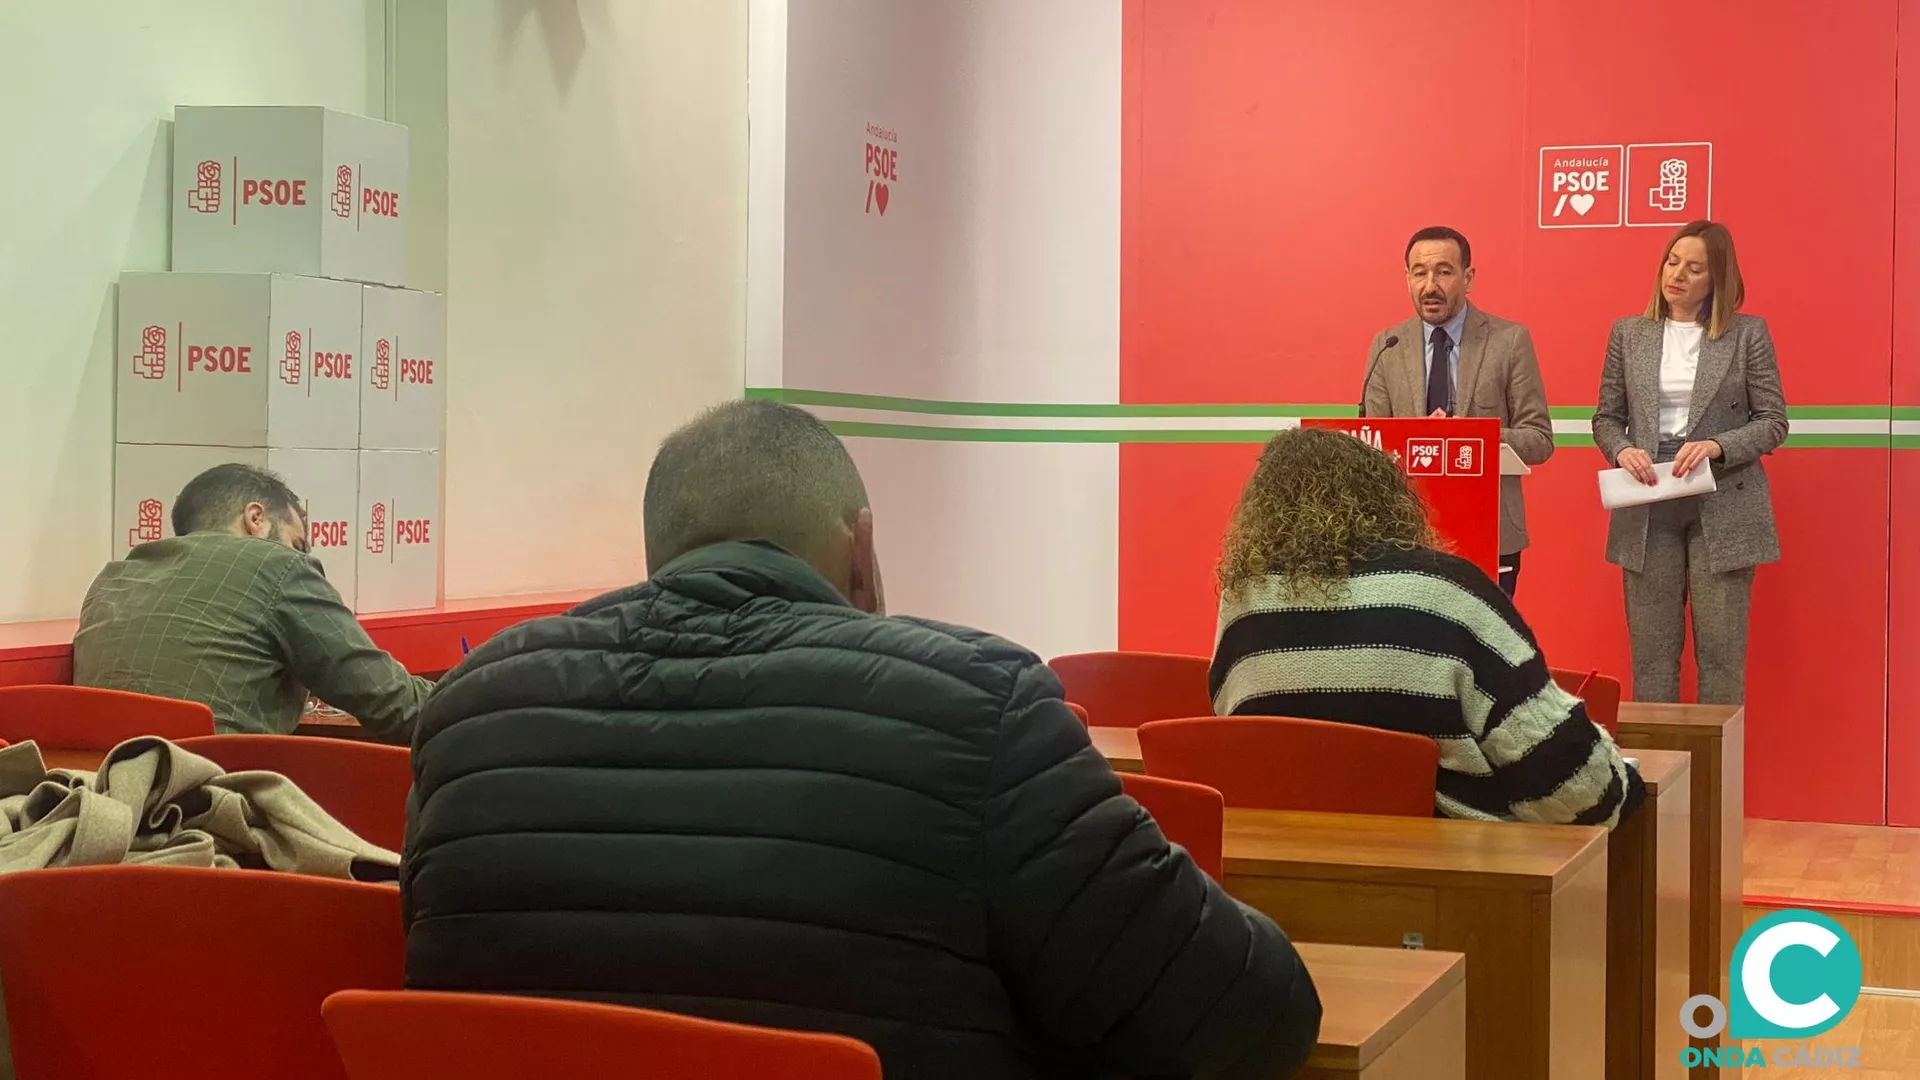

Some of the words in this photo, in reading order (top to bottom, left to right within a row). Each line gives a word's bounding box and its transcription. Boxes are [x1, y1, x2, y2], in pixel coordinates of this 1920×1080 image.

[865, 142, 897, 182] PSOE
[1553, 157, 1609, 168] Andalucía
[242, 179, 306, 206] PSOE
[1552, 170, 1610, 193] PSOE
[363, 187, 399, 218] PSOE
[187, 345, 252, 373] PSOE
[314, 351, 352, 380] PSOE
[400, 358, 434, 385] PSOE
[1411, 445, 1440, 456] PSOE
[310, 520, 348, 548] PSOE
[396, 519, 430, 545] PSOE
